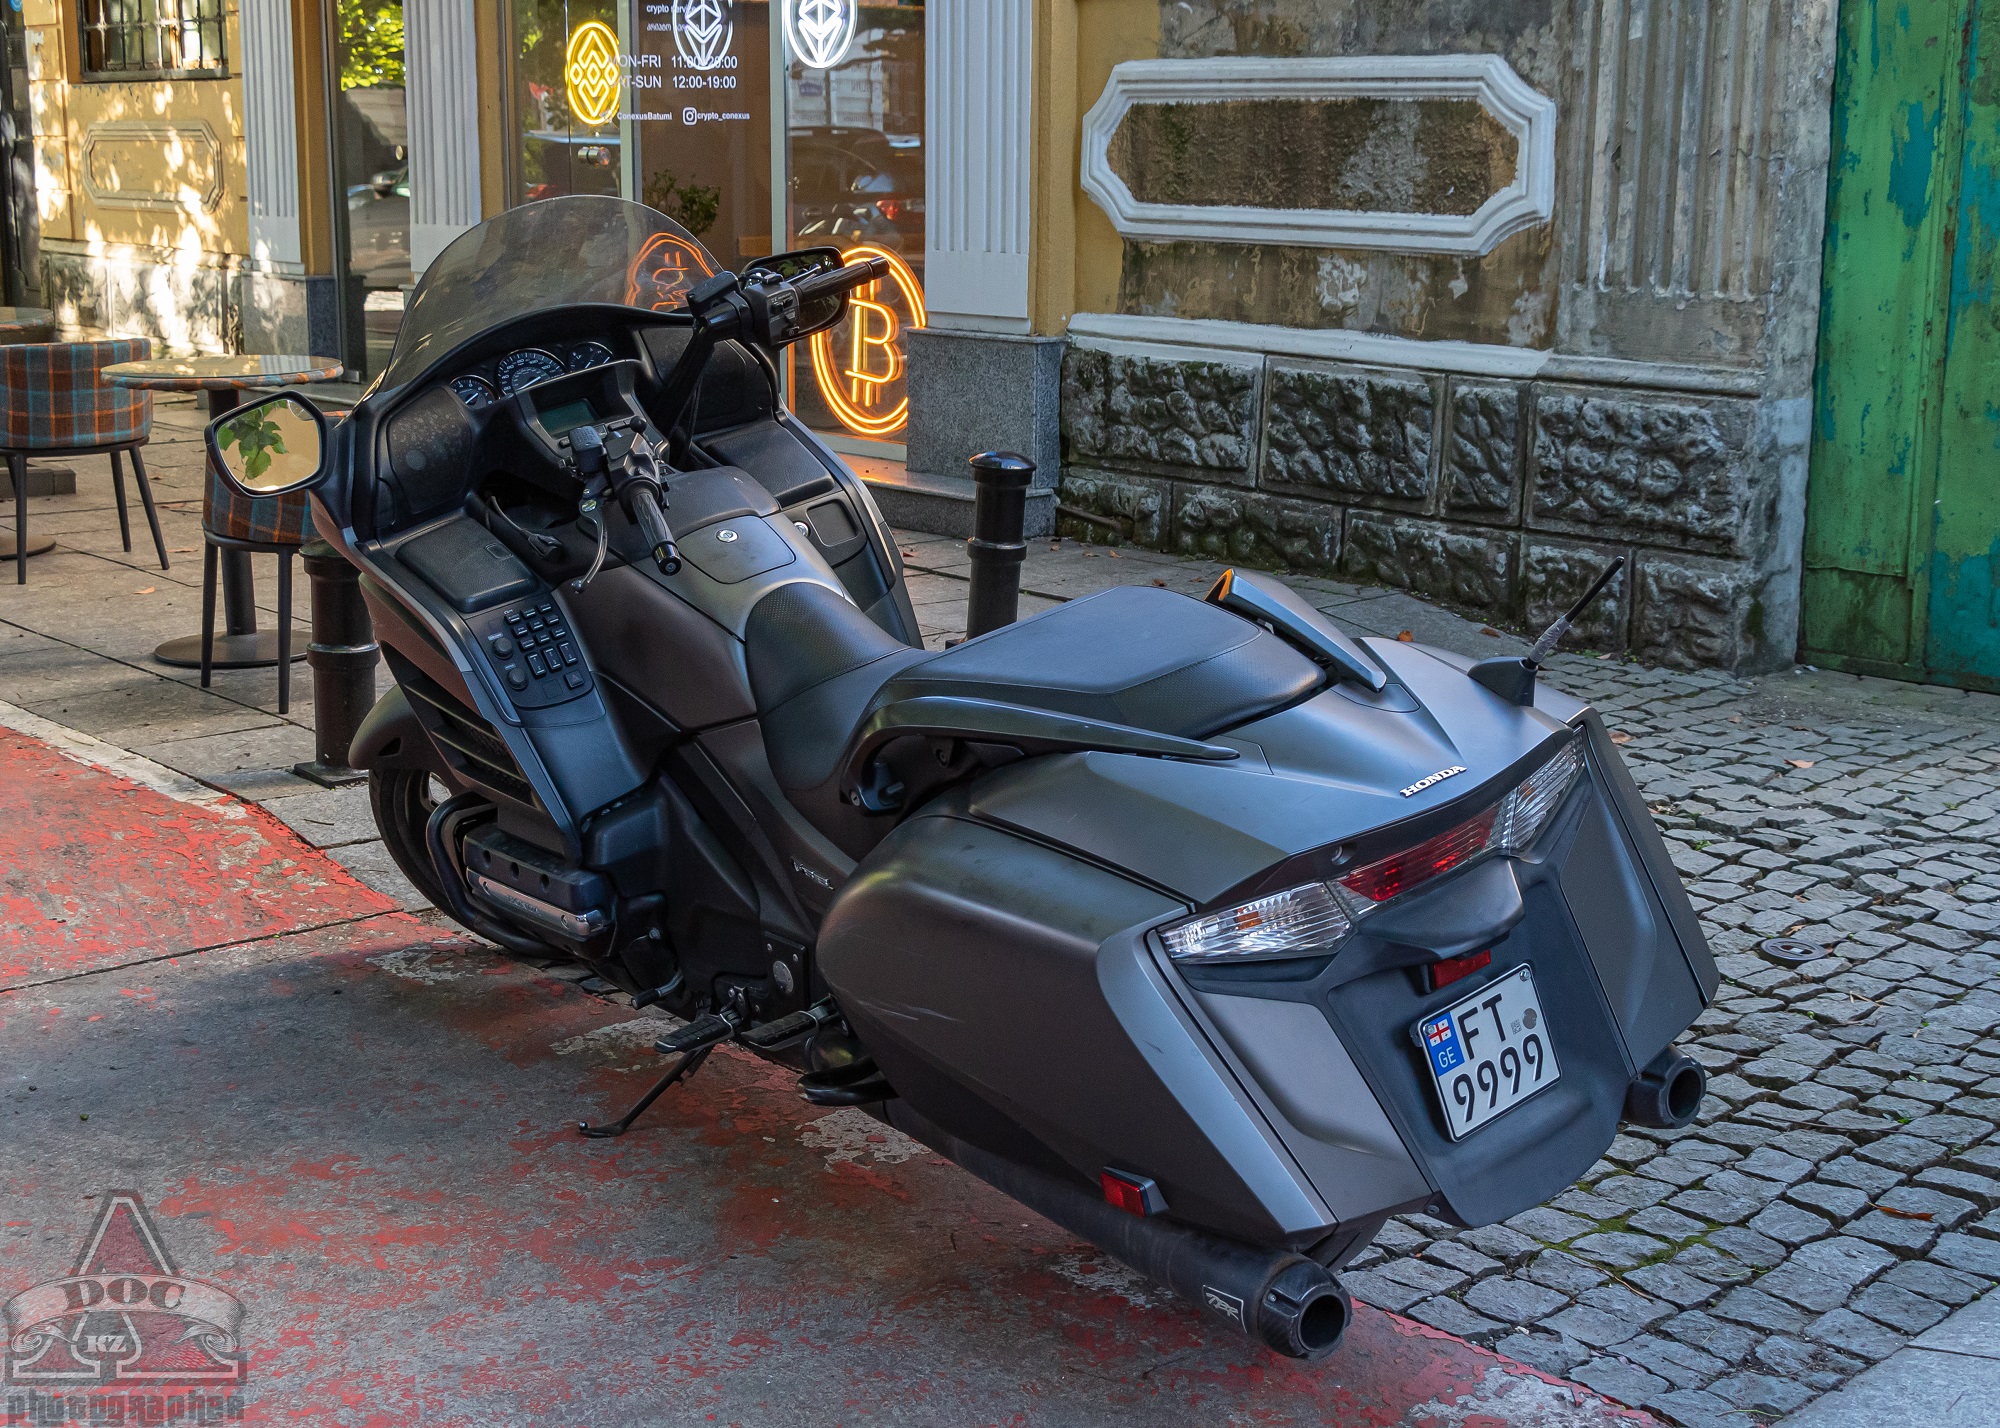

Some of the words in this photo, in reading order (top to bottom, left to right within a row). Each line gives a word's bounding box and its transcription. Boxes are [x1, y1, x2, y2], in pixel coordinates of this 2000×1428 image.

[646, 4, 669, 14] crypto
[671, 56, 738, 69] 11:0020:00
[610, 75, 662, 89] AT-SUN
[672, 75, 737, 89] 12:00-19:00
[617, 111, 673, 121] ConexusBatumi
[697, 111, 750, 122] crypto_conexus
[1400, 765, 1468, 798] HONDA
[1457, 993, 1506, 1061] FT
[1438, 1046, 1457, 1069] GE
[1452, 1033, 1544, 1123] 9999
